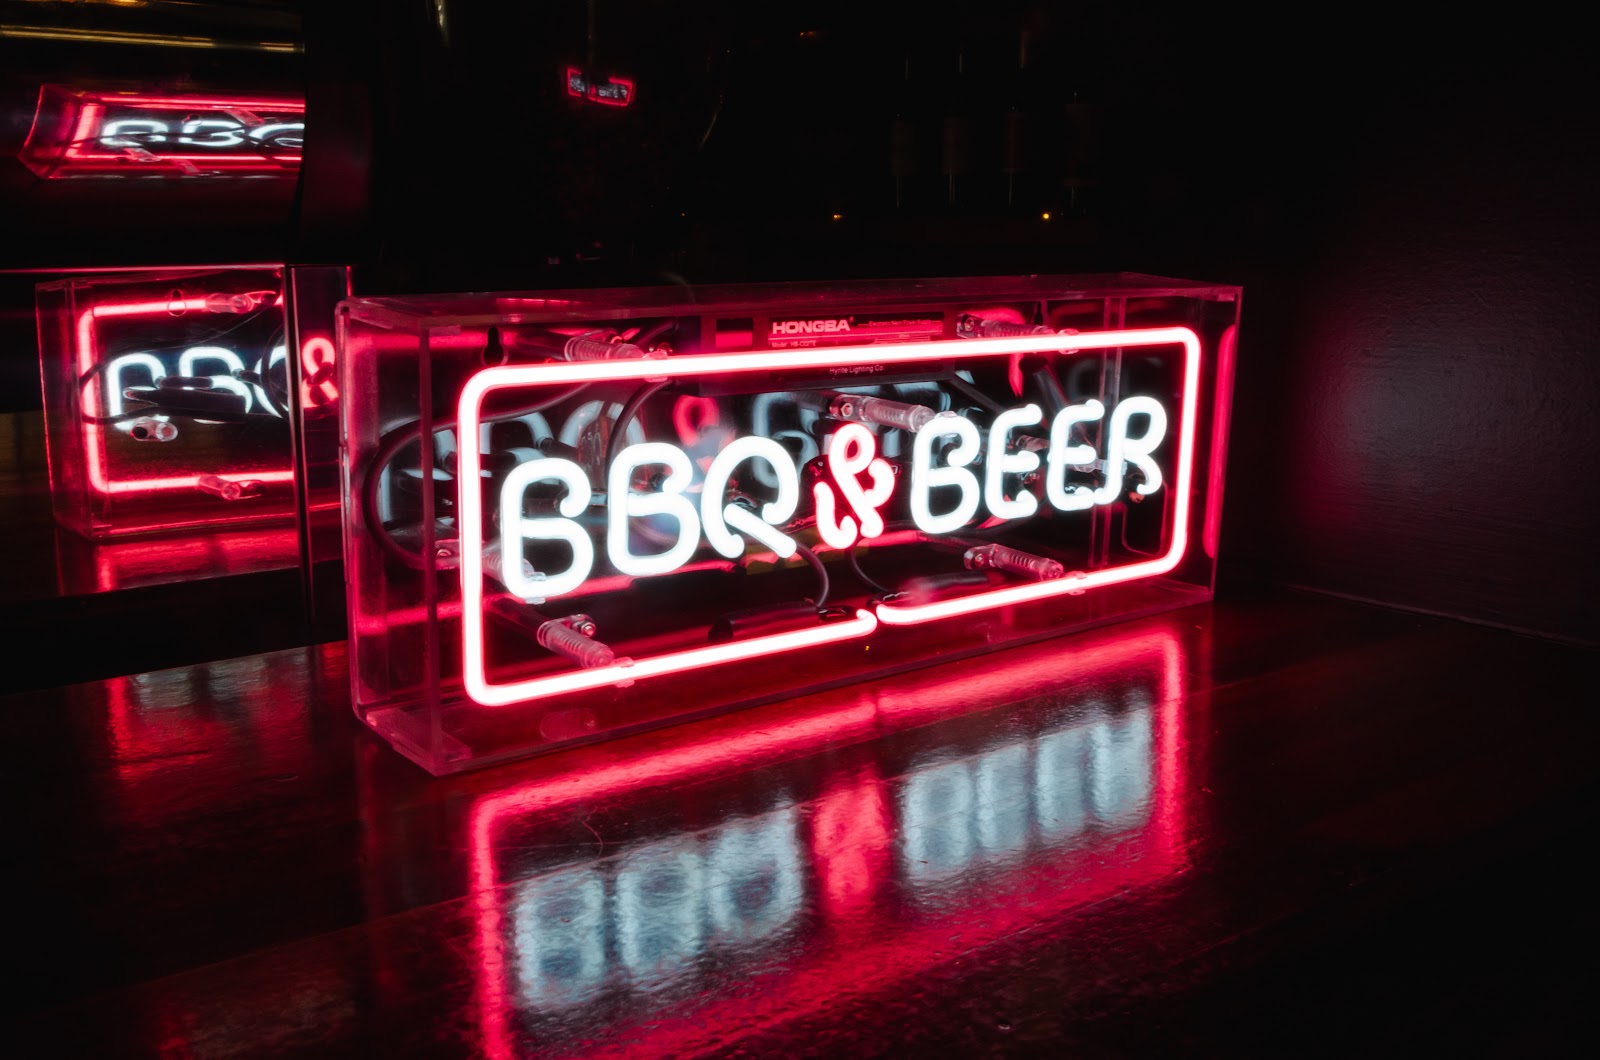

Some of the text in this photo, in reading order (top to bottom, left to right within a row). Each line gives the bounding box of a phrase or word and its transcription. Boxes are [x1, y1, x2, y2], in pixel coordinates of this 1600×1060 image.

[772, 319, 851, 335] HONGBA
[849, 365, 874, 375] Lighting
[500, 396, 1168, 600] BBQ & BEER
